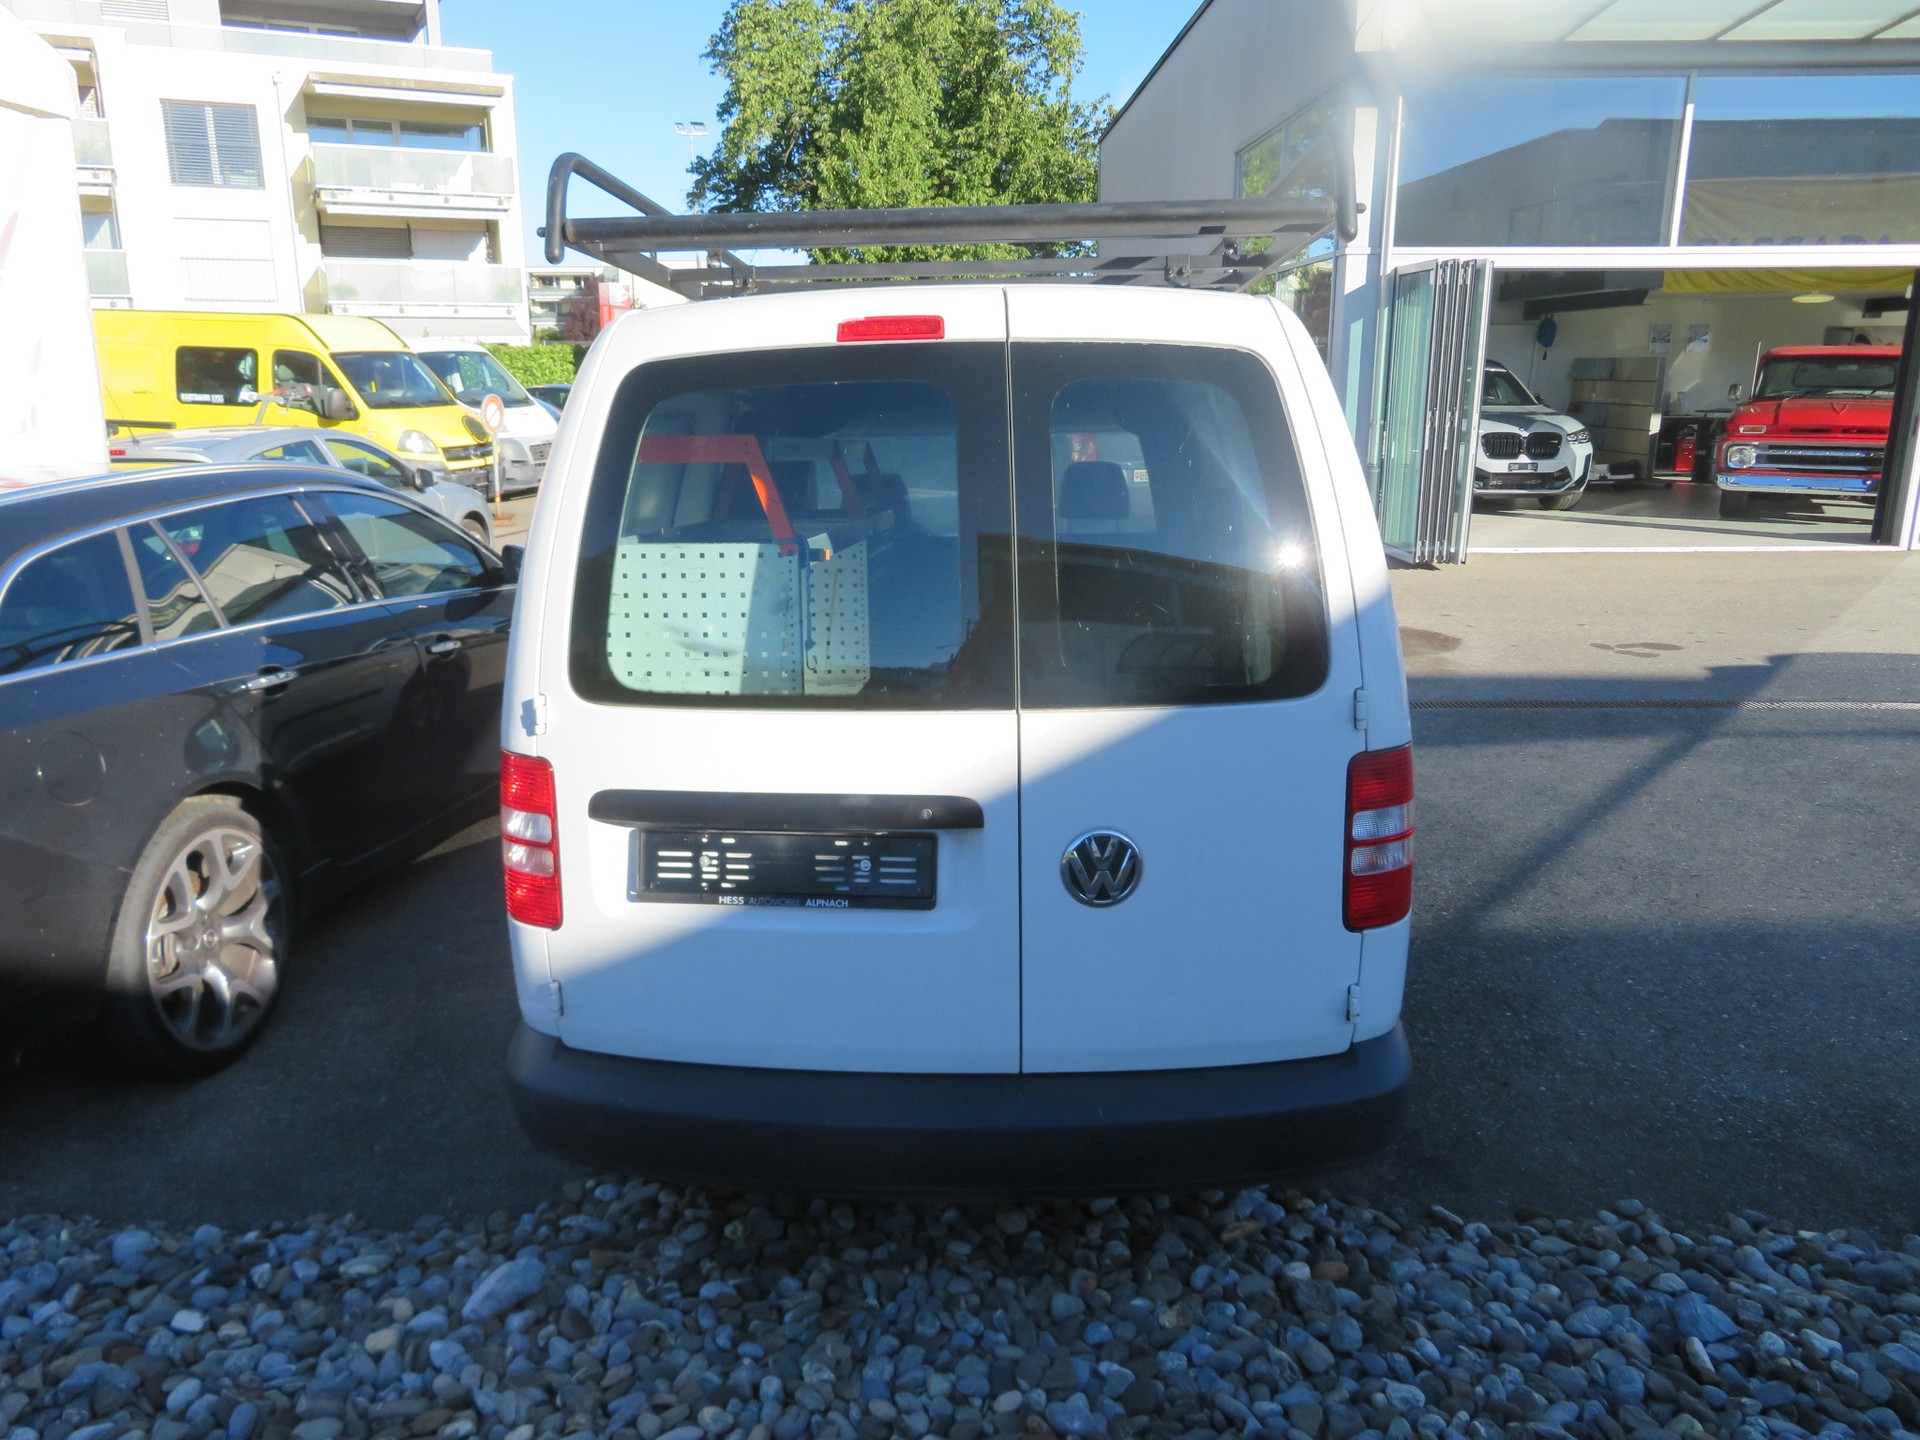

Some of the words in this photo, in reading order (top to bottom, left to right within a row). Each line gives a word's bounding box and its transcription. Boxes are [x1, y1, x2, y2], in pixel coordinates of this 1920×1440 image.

[1062, 832, 1140, 904] VW
[718, 896, 745, 905] HESS
[805, 898, 849, 908] ALPNACH
